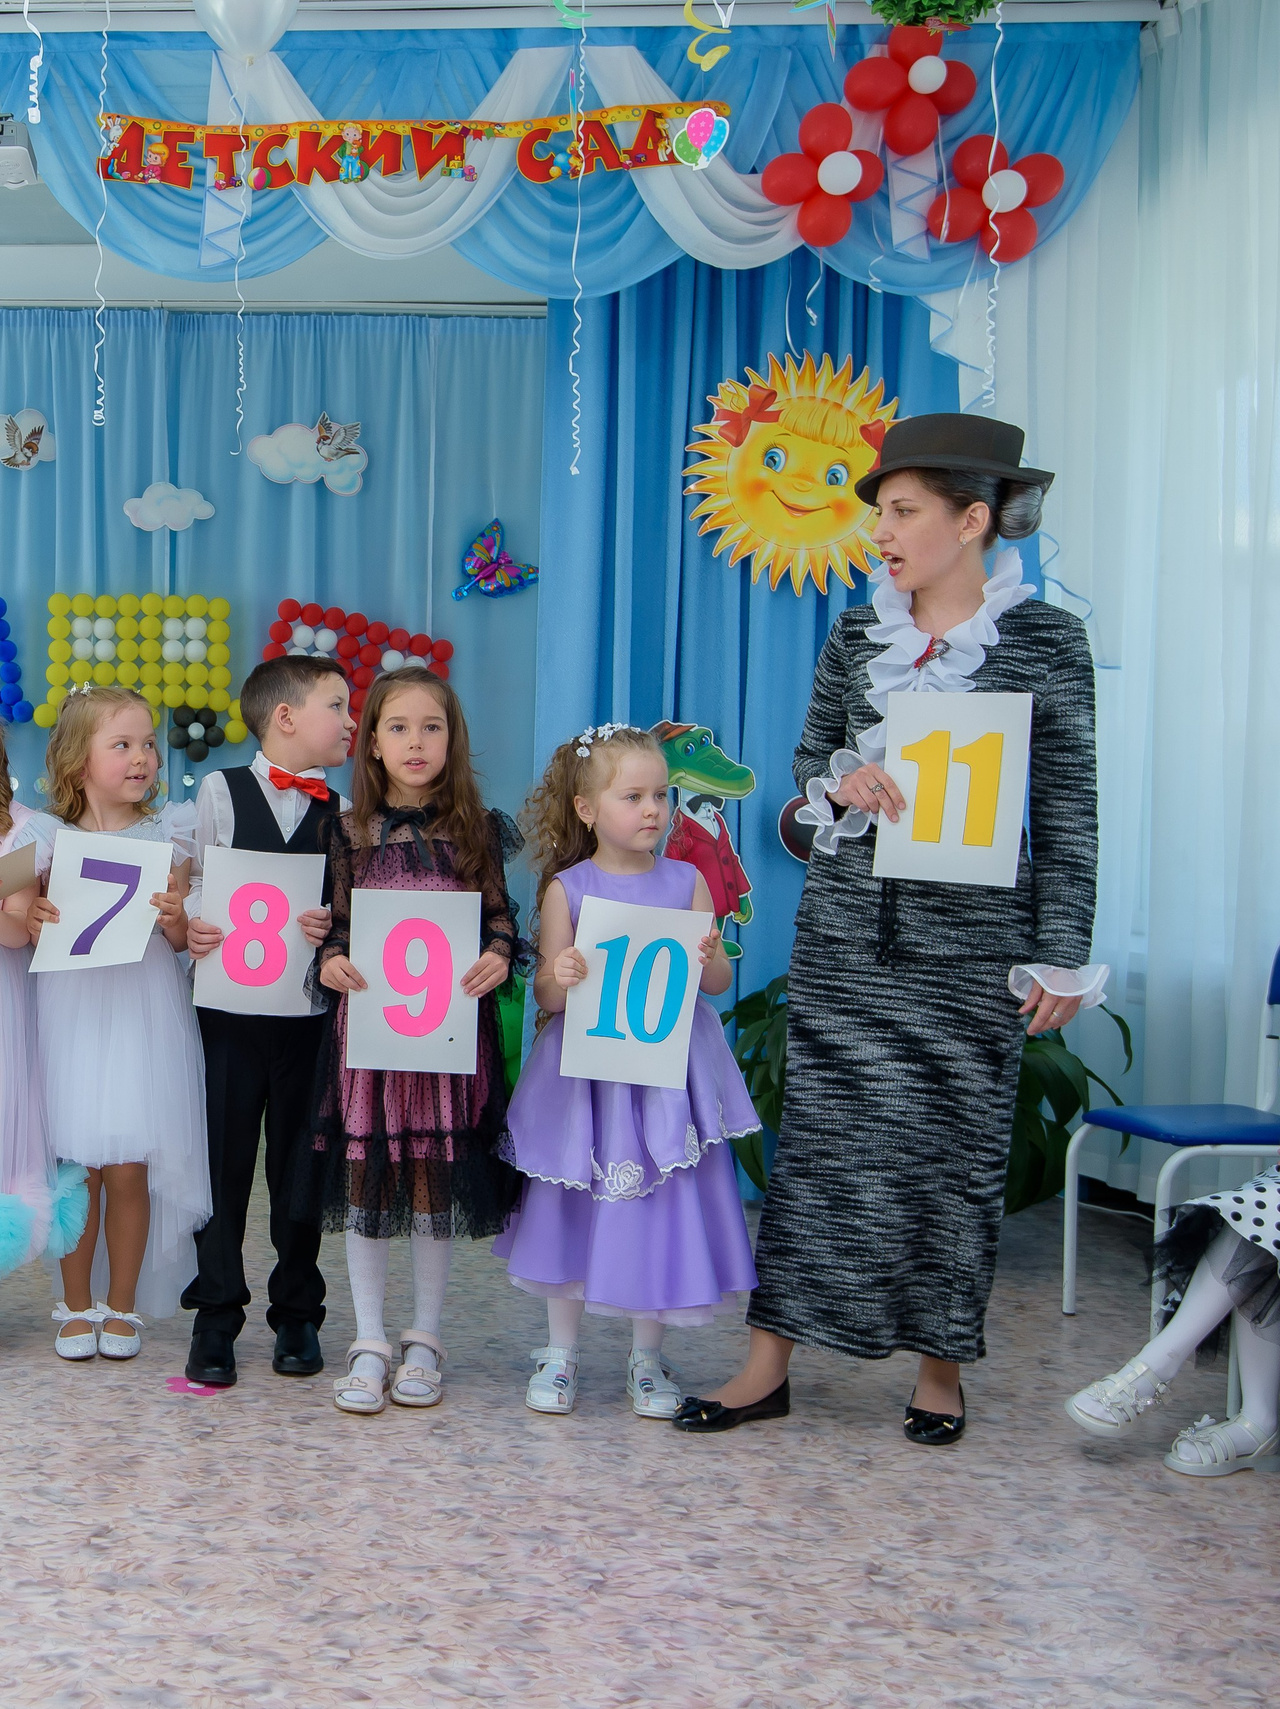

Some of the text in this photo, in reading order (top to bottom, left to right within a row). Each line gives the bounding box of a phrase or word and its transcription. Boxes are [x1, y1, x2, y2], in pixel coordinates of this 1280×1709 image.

[97, 109, 685, 191] ДЕТСКИЙ САД
[901, 731, 1004, 847] 11
[70, 858, 141, 955] 7
[220, 882, 290, 987] 8
[382, 918, 453, 1037] 9
[586, 935, 689, 1044] 10
